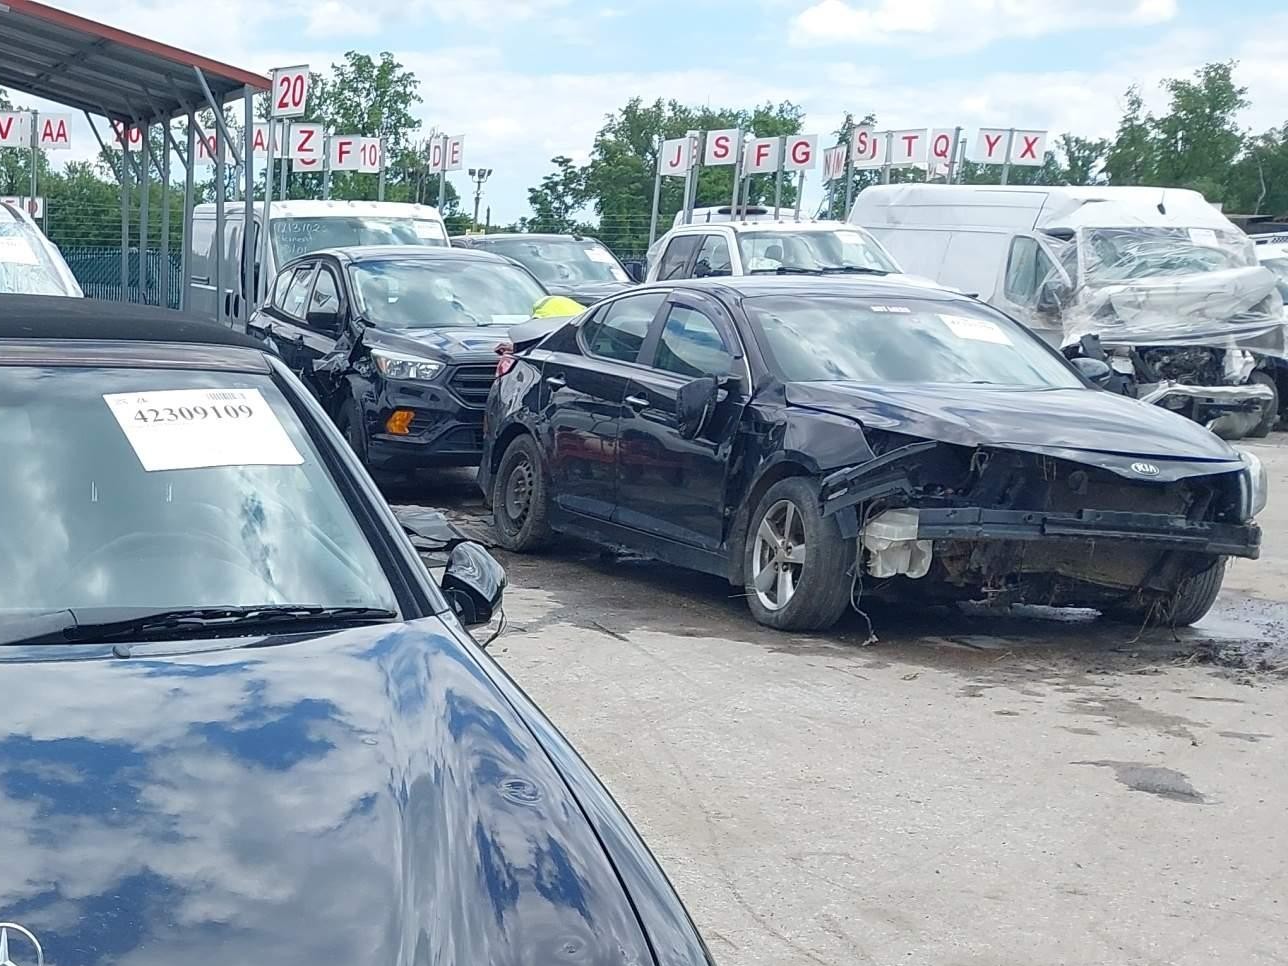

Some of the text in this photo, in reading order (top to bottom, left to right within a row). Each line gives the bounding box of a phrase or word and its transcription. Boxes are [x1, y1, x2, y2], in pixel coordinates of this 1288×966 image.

[278, 75, 304, 109] 20
[41, 119, 68, 142] AA
[297, 130, 314, 152] Z
[338, 142, 352, 164] F
[451, 142, 459, 164] E
[713, 136, 730, 158] S
[792, 141, 810, 164] G
[858, 131, 868, 155] S
[902, 136, 919, 157] T
[933, 134, 950, 158] Q
[985, 135, 1002, 157] Y
[1020, 136, 1039, 158] X
[360, 144, 377, 167] 10
[432, 145, 442, 167] D
[669, 145, 682, 167] J
[756, 144, 771, 166] F
[134, 404, 254, 423] 42309109
[1133, 462, 1158, 473] KIA
